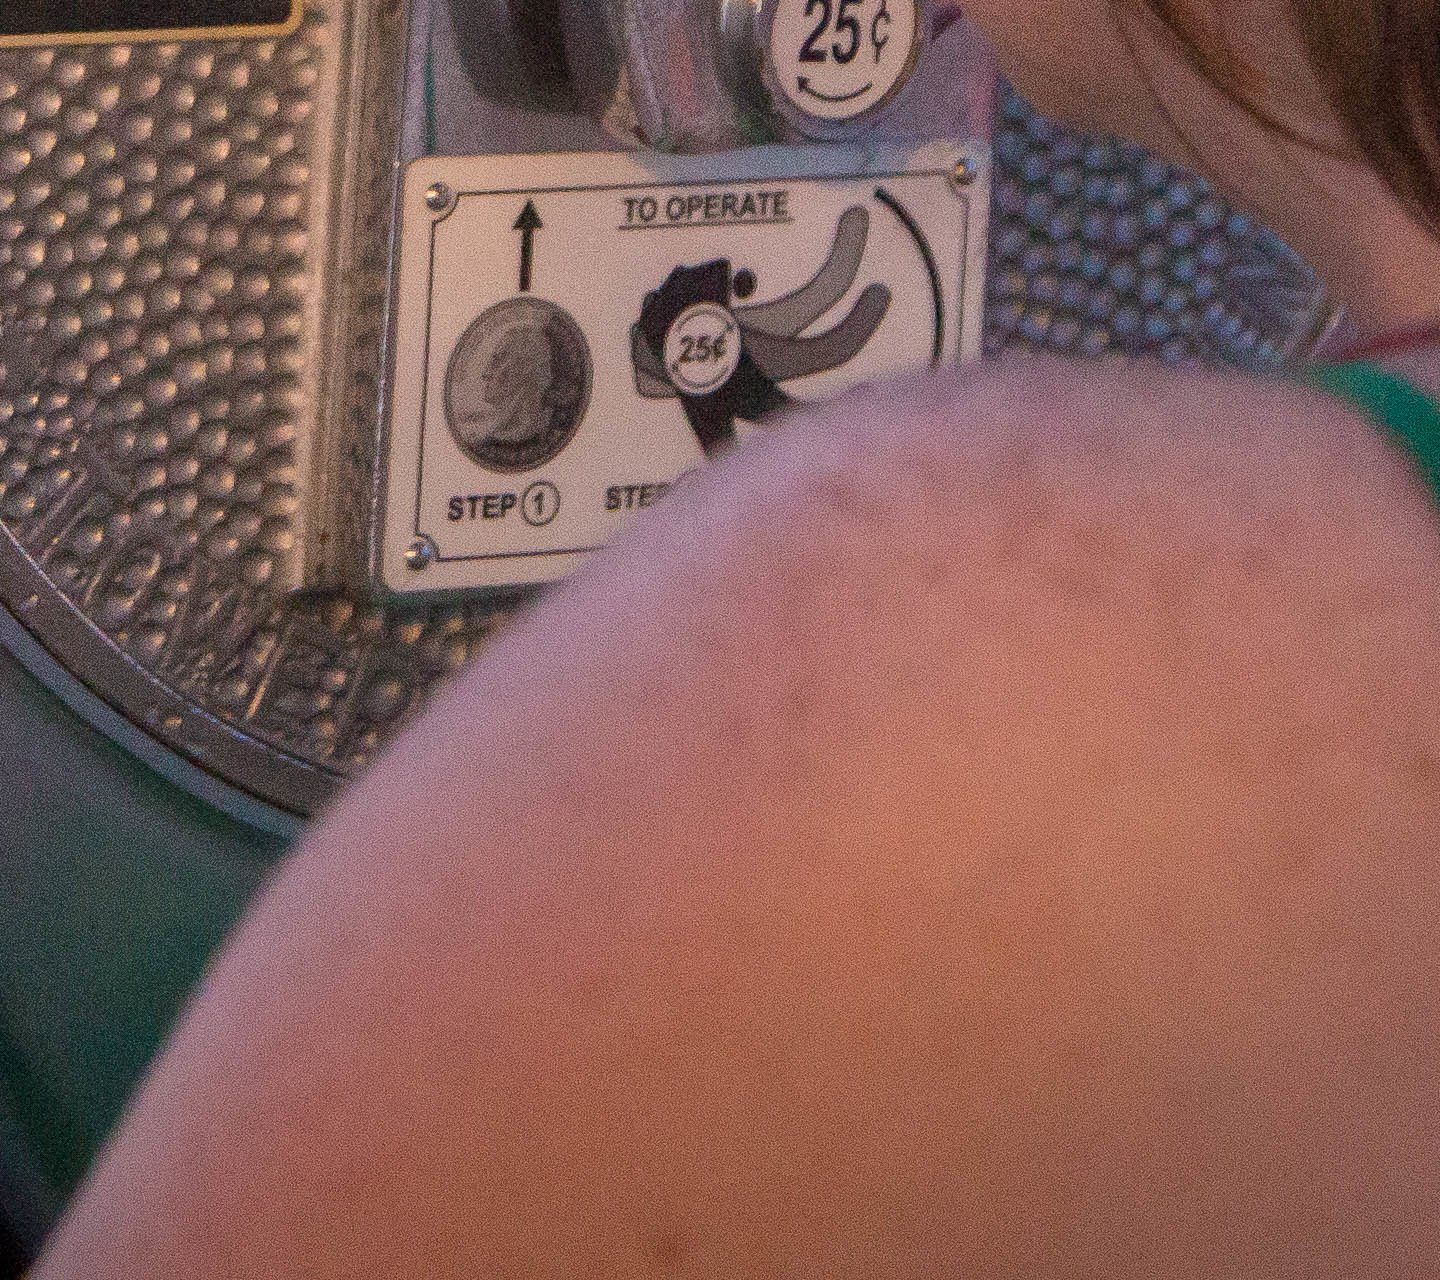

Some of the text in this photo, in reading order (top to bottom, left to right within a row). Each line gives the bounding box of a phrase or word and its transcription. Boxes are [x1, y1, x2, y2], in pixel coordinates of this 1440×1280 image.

[623, 189, 790, 223] TO OPERATE
[447, 492, 518, 522] STEP
